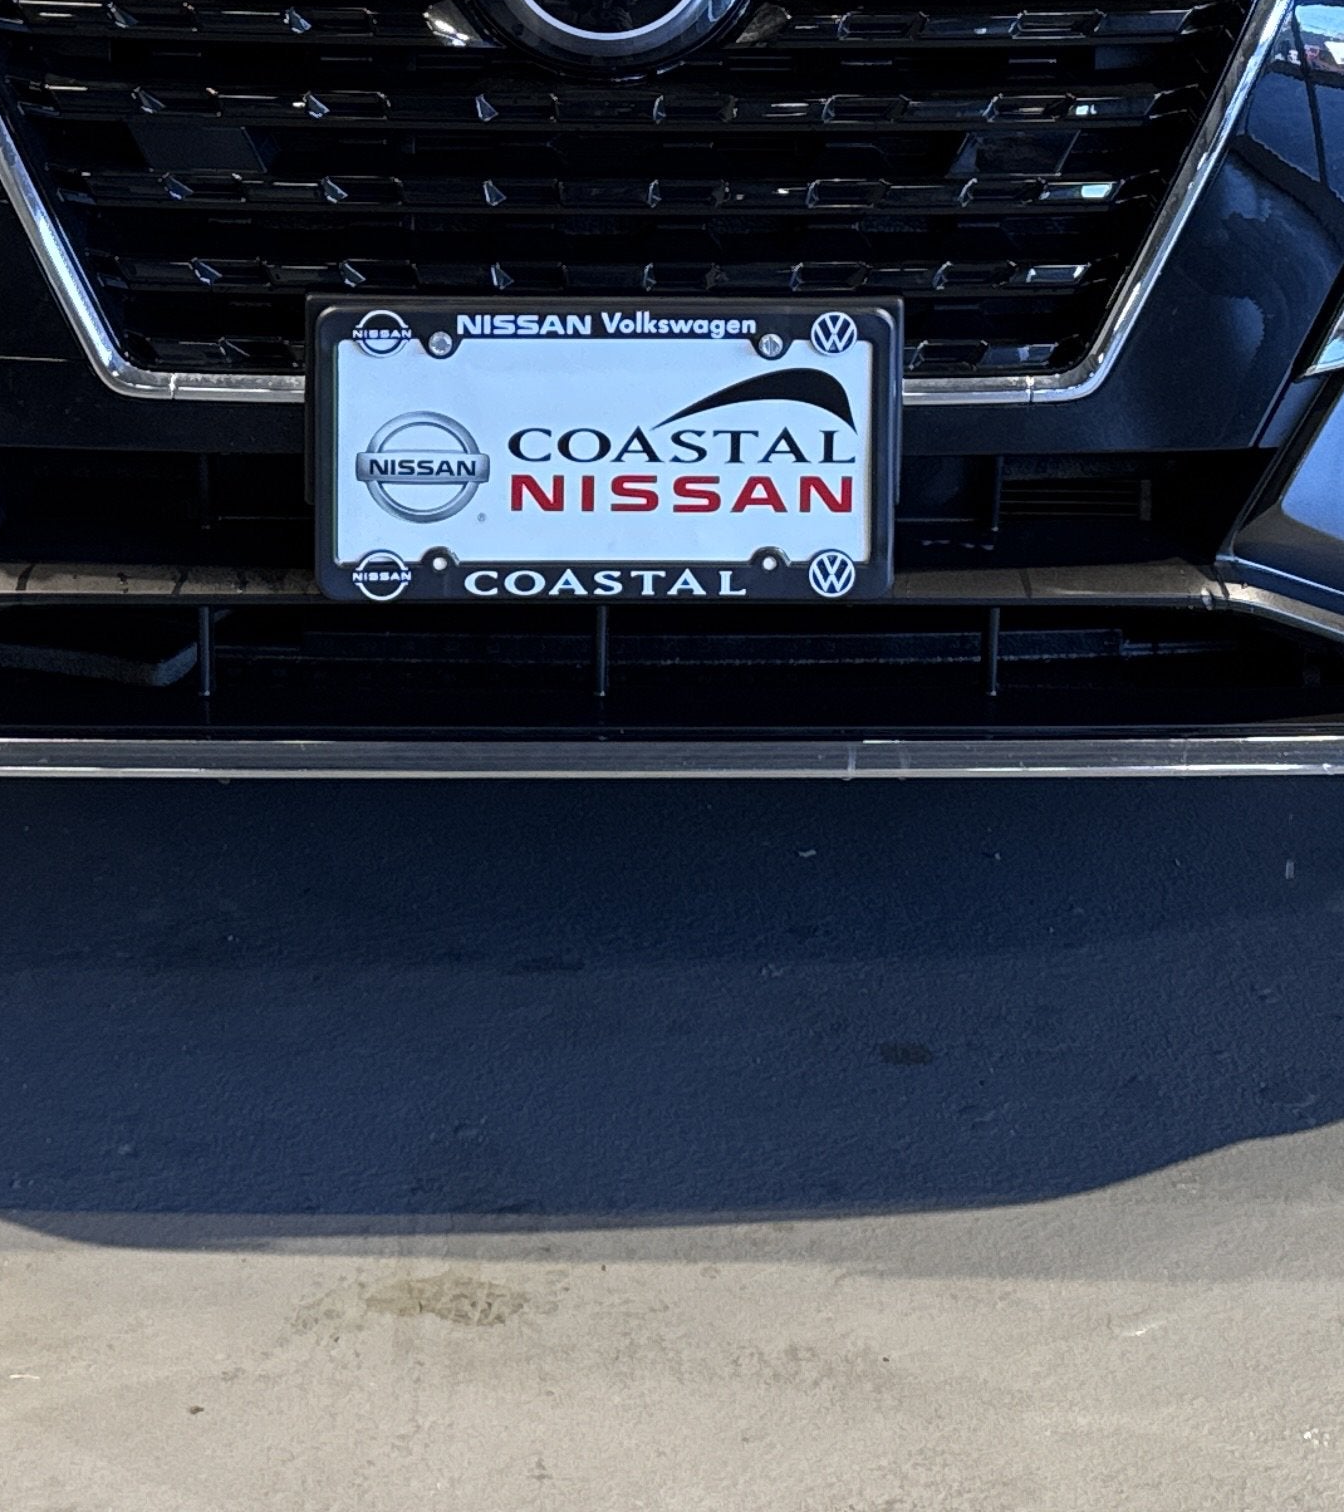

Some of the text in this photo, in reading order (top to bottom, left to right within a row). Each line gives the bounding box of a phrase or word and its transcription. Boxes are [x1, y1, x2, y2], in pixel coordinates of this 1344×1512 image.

[352, 329, 412, 339] NISSAN
[456, 310, 757, 338] NISSAN Volkswagen
[507, 425, 857, 464] COASTAL
[369, 459, 477, 477] NISSAN
[510, 474, 853, 513] NISSAN
[352, 571, 412, 582] NISSAN
[464, 568, 747, 596] COASTAL
